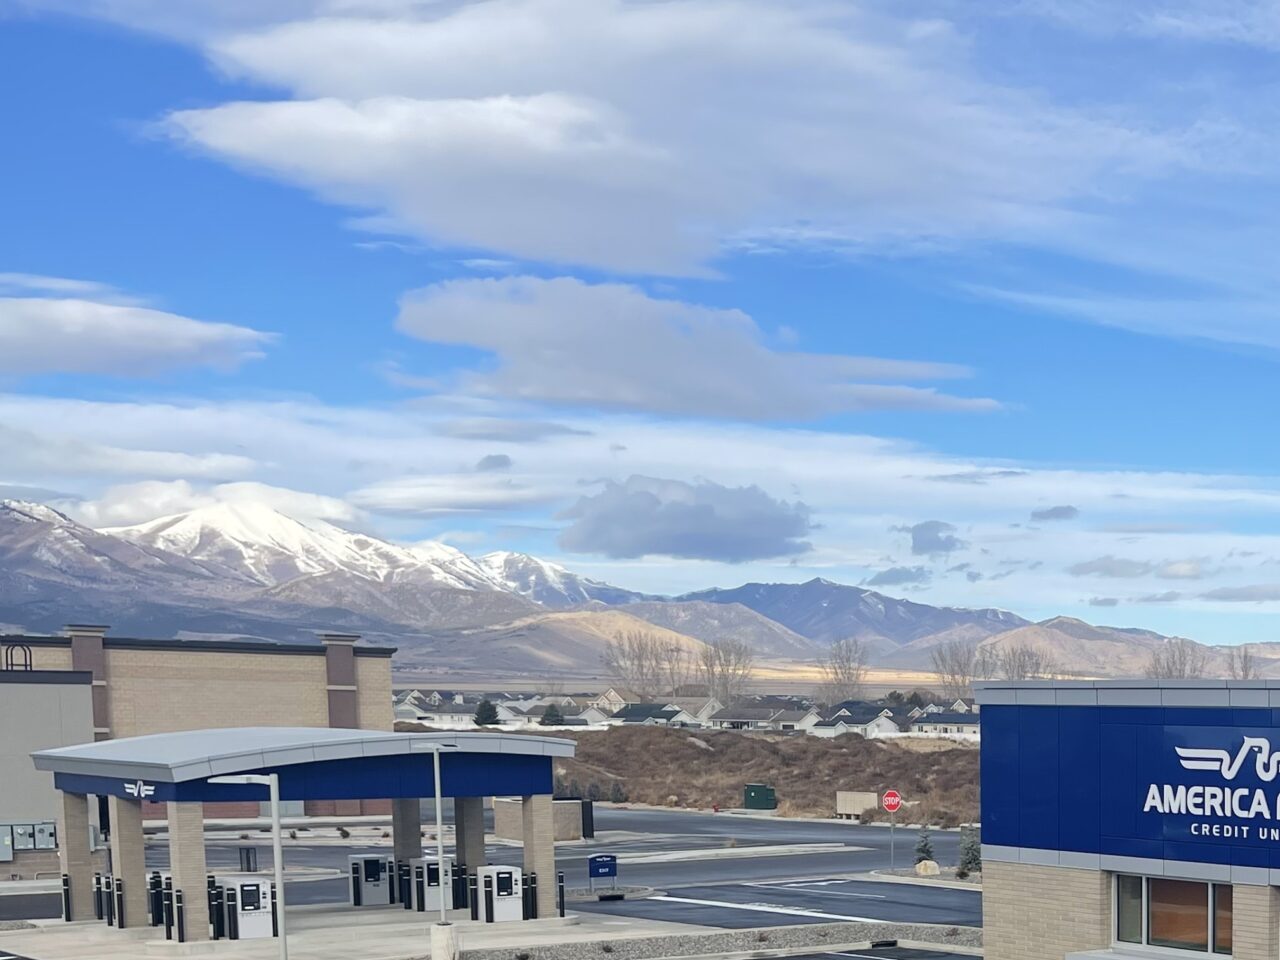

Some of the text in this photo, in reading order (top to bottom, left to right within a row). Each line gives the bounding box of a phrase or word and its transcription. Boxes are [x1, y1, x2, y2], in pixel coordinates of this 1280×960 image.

[884, 796, 900, 806] STOP
[1143, 784, 1271, 820] AMERICA
[1190, 823, 1250, 839] CREDIT
